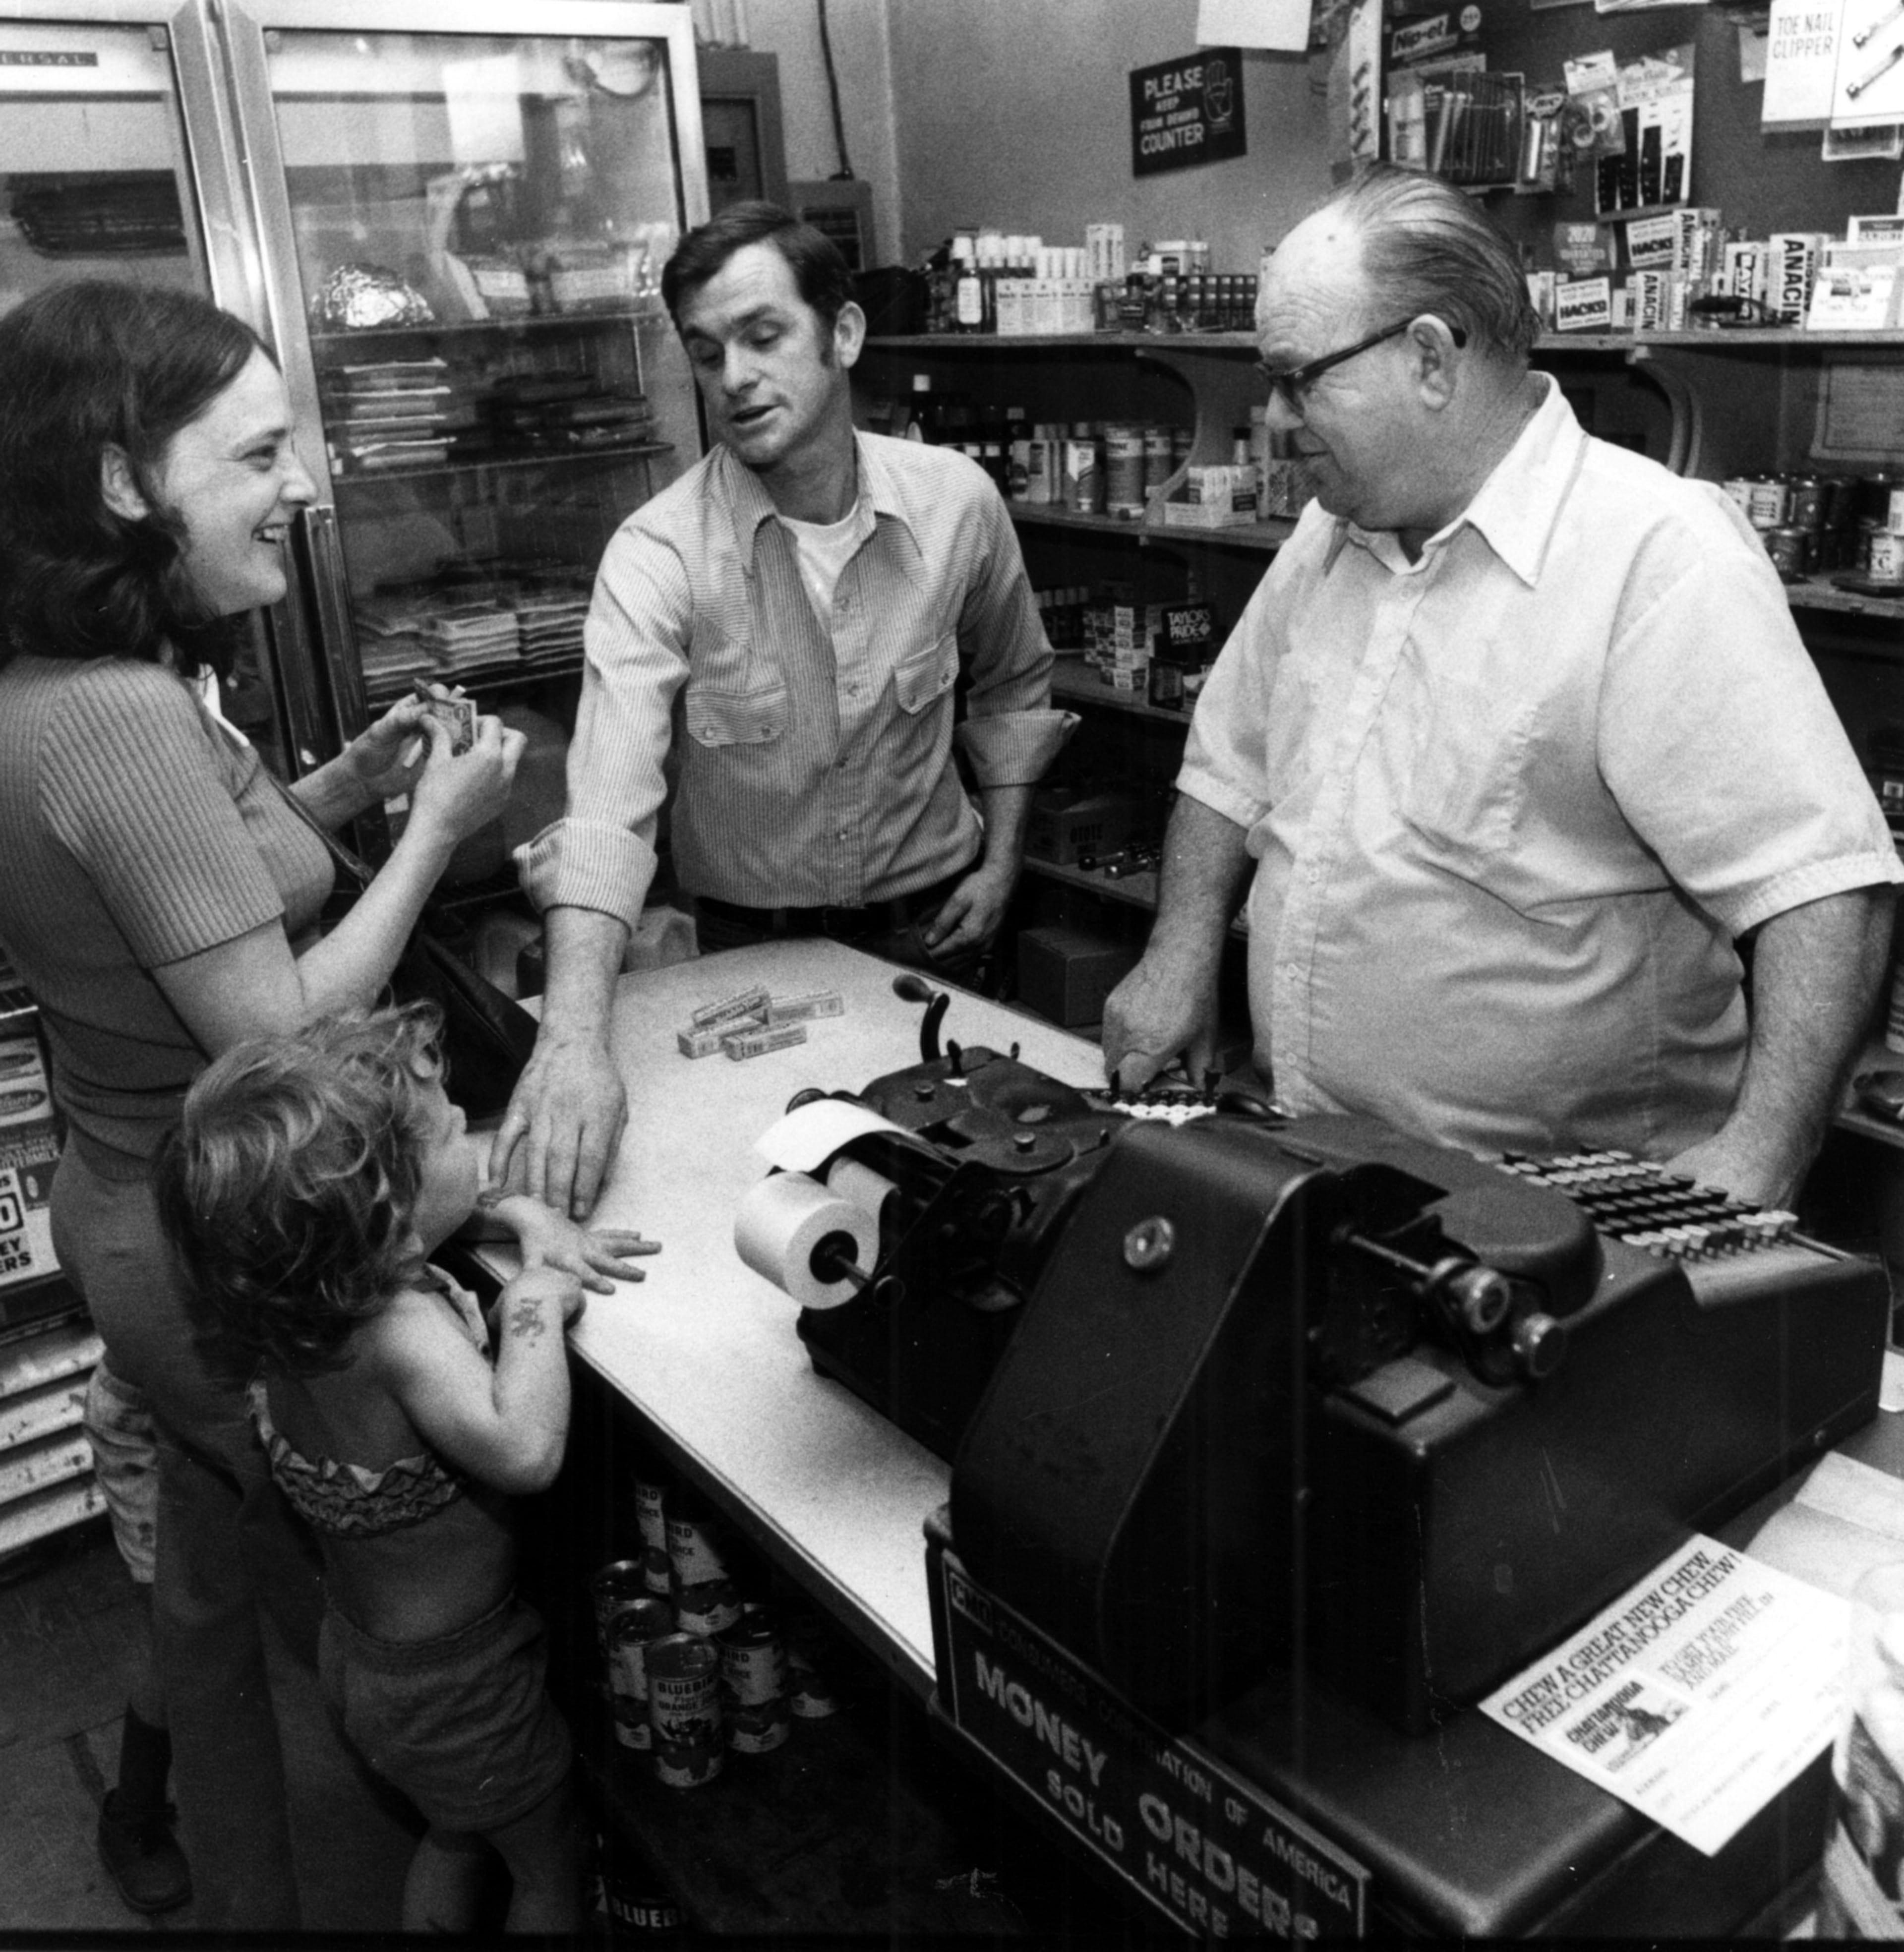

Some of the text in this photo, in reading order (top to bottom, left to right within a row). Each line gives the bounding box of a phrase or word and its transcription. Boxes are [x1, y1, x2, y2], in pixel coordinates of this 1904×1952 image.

[1773, 36, 1833, 59] CLIPPER
[1777, 12, 1833, 36] TOE NAIL
[1145, 66, 1203, 101] PLEASE
[1141, 122, 1204, 155] COUNTER
[1641, 274, 1658, 330] ANACIN
[1782, 239, 1805, 324] ANACIN
[1170, 622, 1200, 639] PRIDE
[1502, 1550, 1710, 1718] CHEW A GREAT NEW CHEW
[1520, 1552, 1742, 1734] FREE CHATTANOOGA CHEW!
[658, 1674, 714, 1695] BLUEBIR
[975, 1651, 1108, 1786] MONEY
[999, 1621, 1088, 1706] CONSUMERS
[1098, 1700, 1212, 1803] COATION
[1225, 1797, 1249, 1827] OF
[1262, 1827, 1352, 1911] AMERICA
[1047, 1770, 1229, 1939] SOLD HERE
